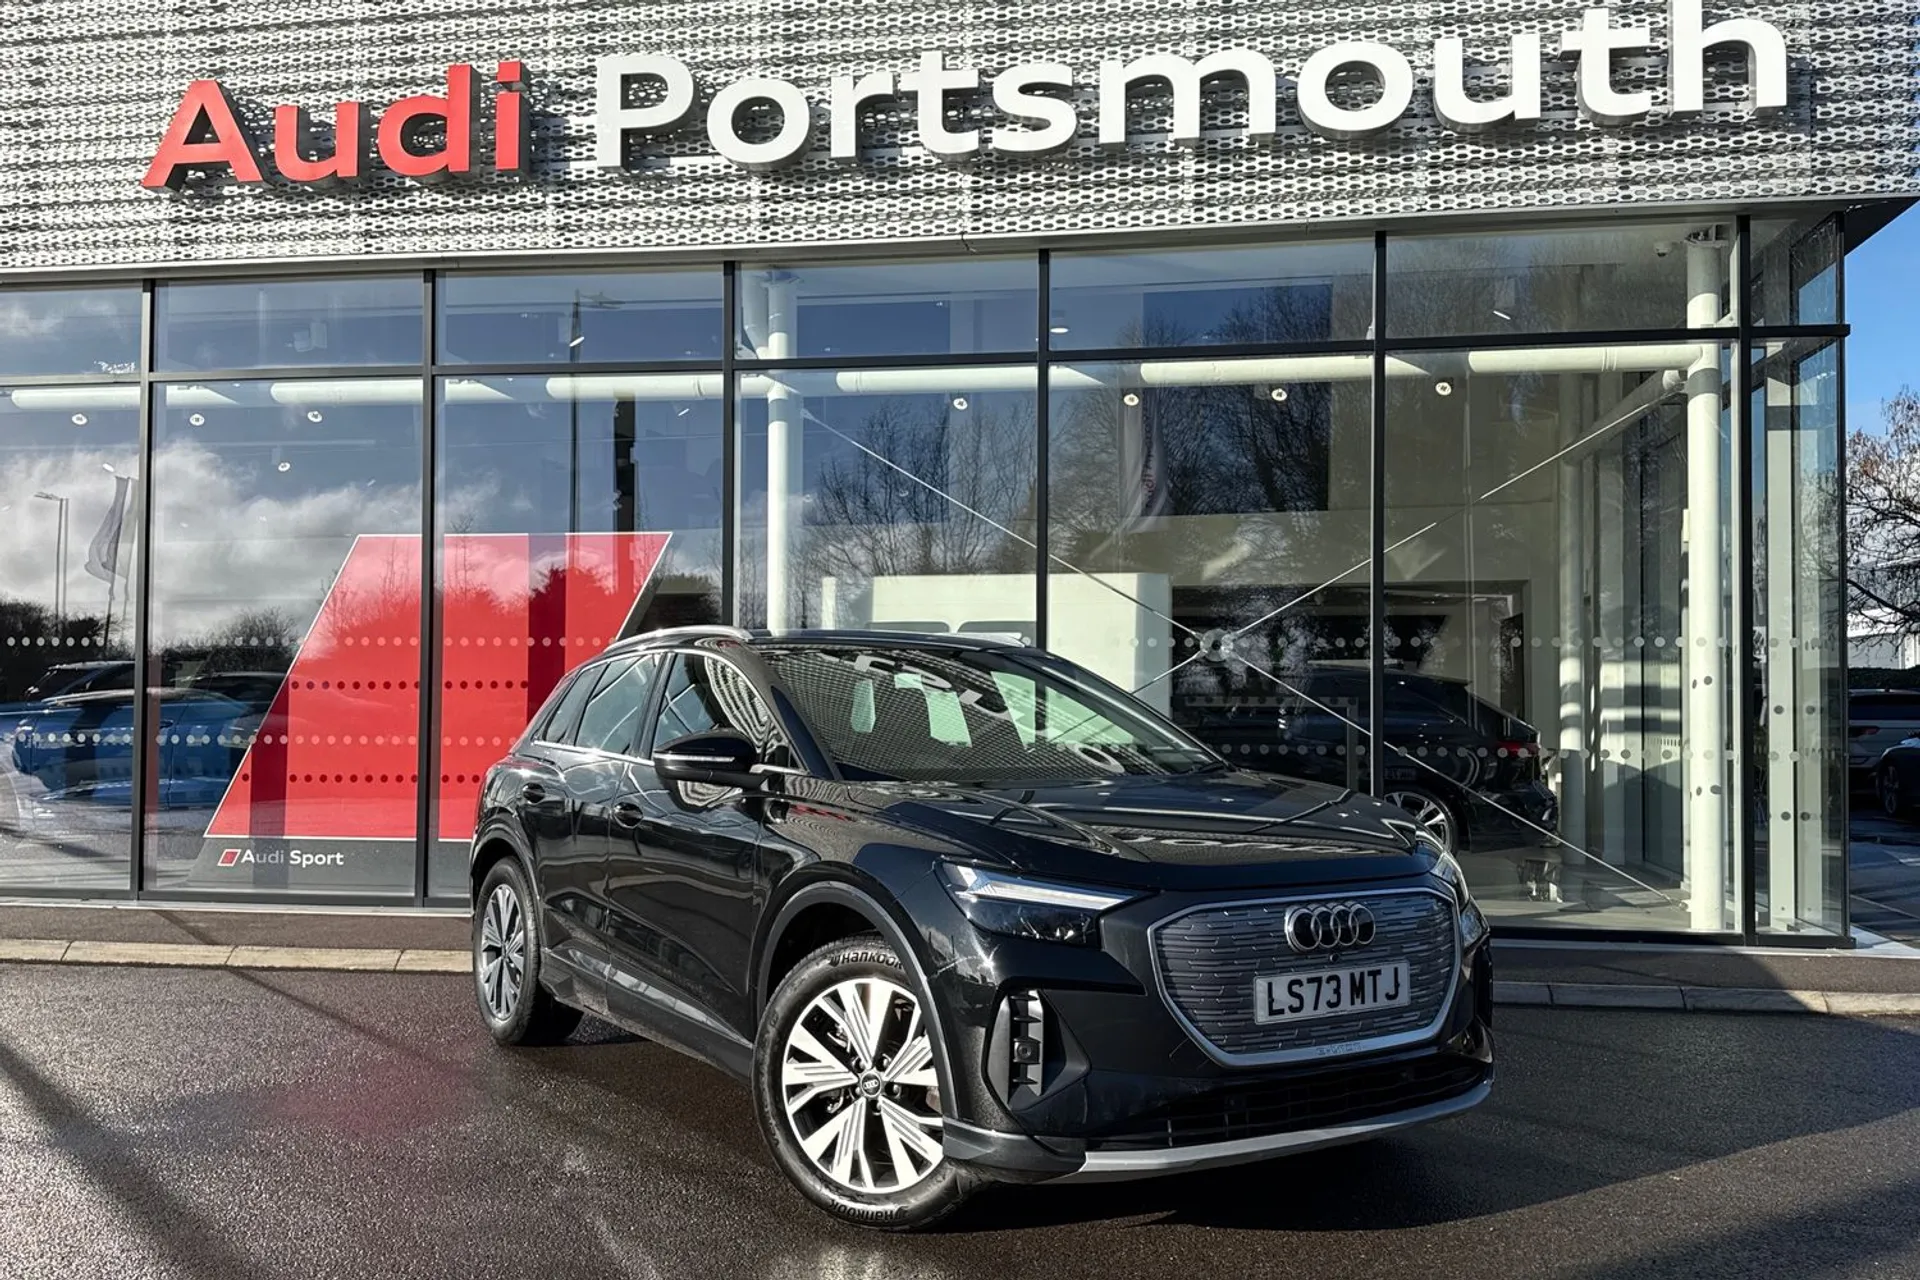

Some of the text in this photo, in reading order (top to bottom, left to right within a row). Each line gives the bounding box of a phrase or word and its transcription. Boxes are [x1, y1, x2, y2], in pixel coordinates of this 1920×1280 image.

[141, 0, 1788, 189] Audi Portsmouth
[241, 849, 345, 868] Audi Sport
[1267, 967, 1400, 1016] LS73 MTJ
